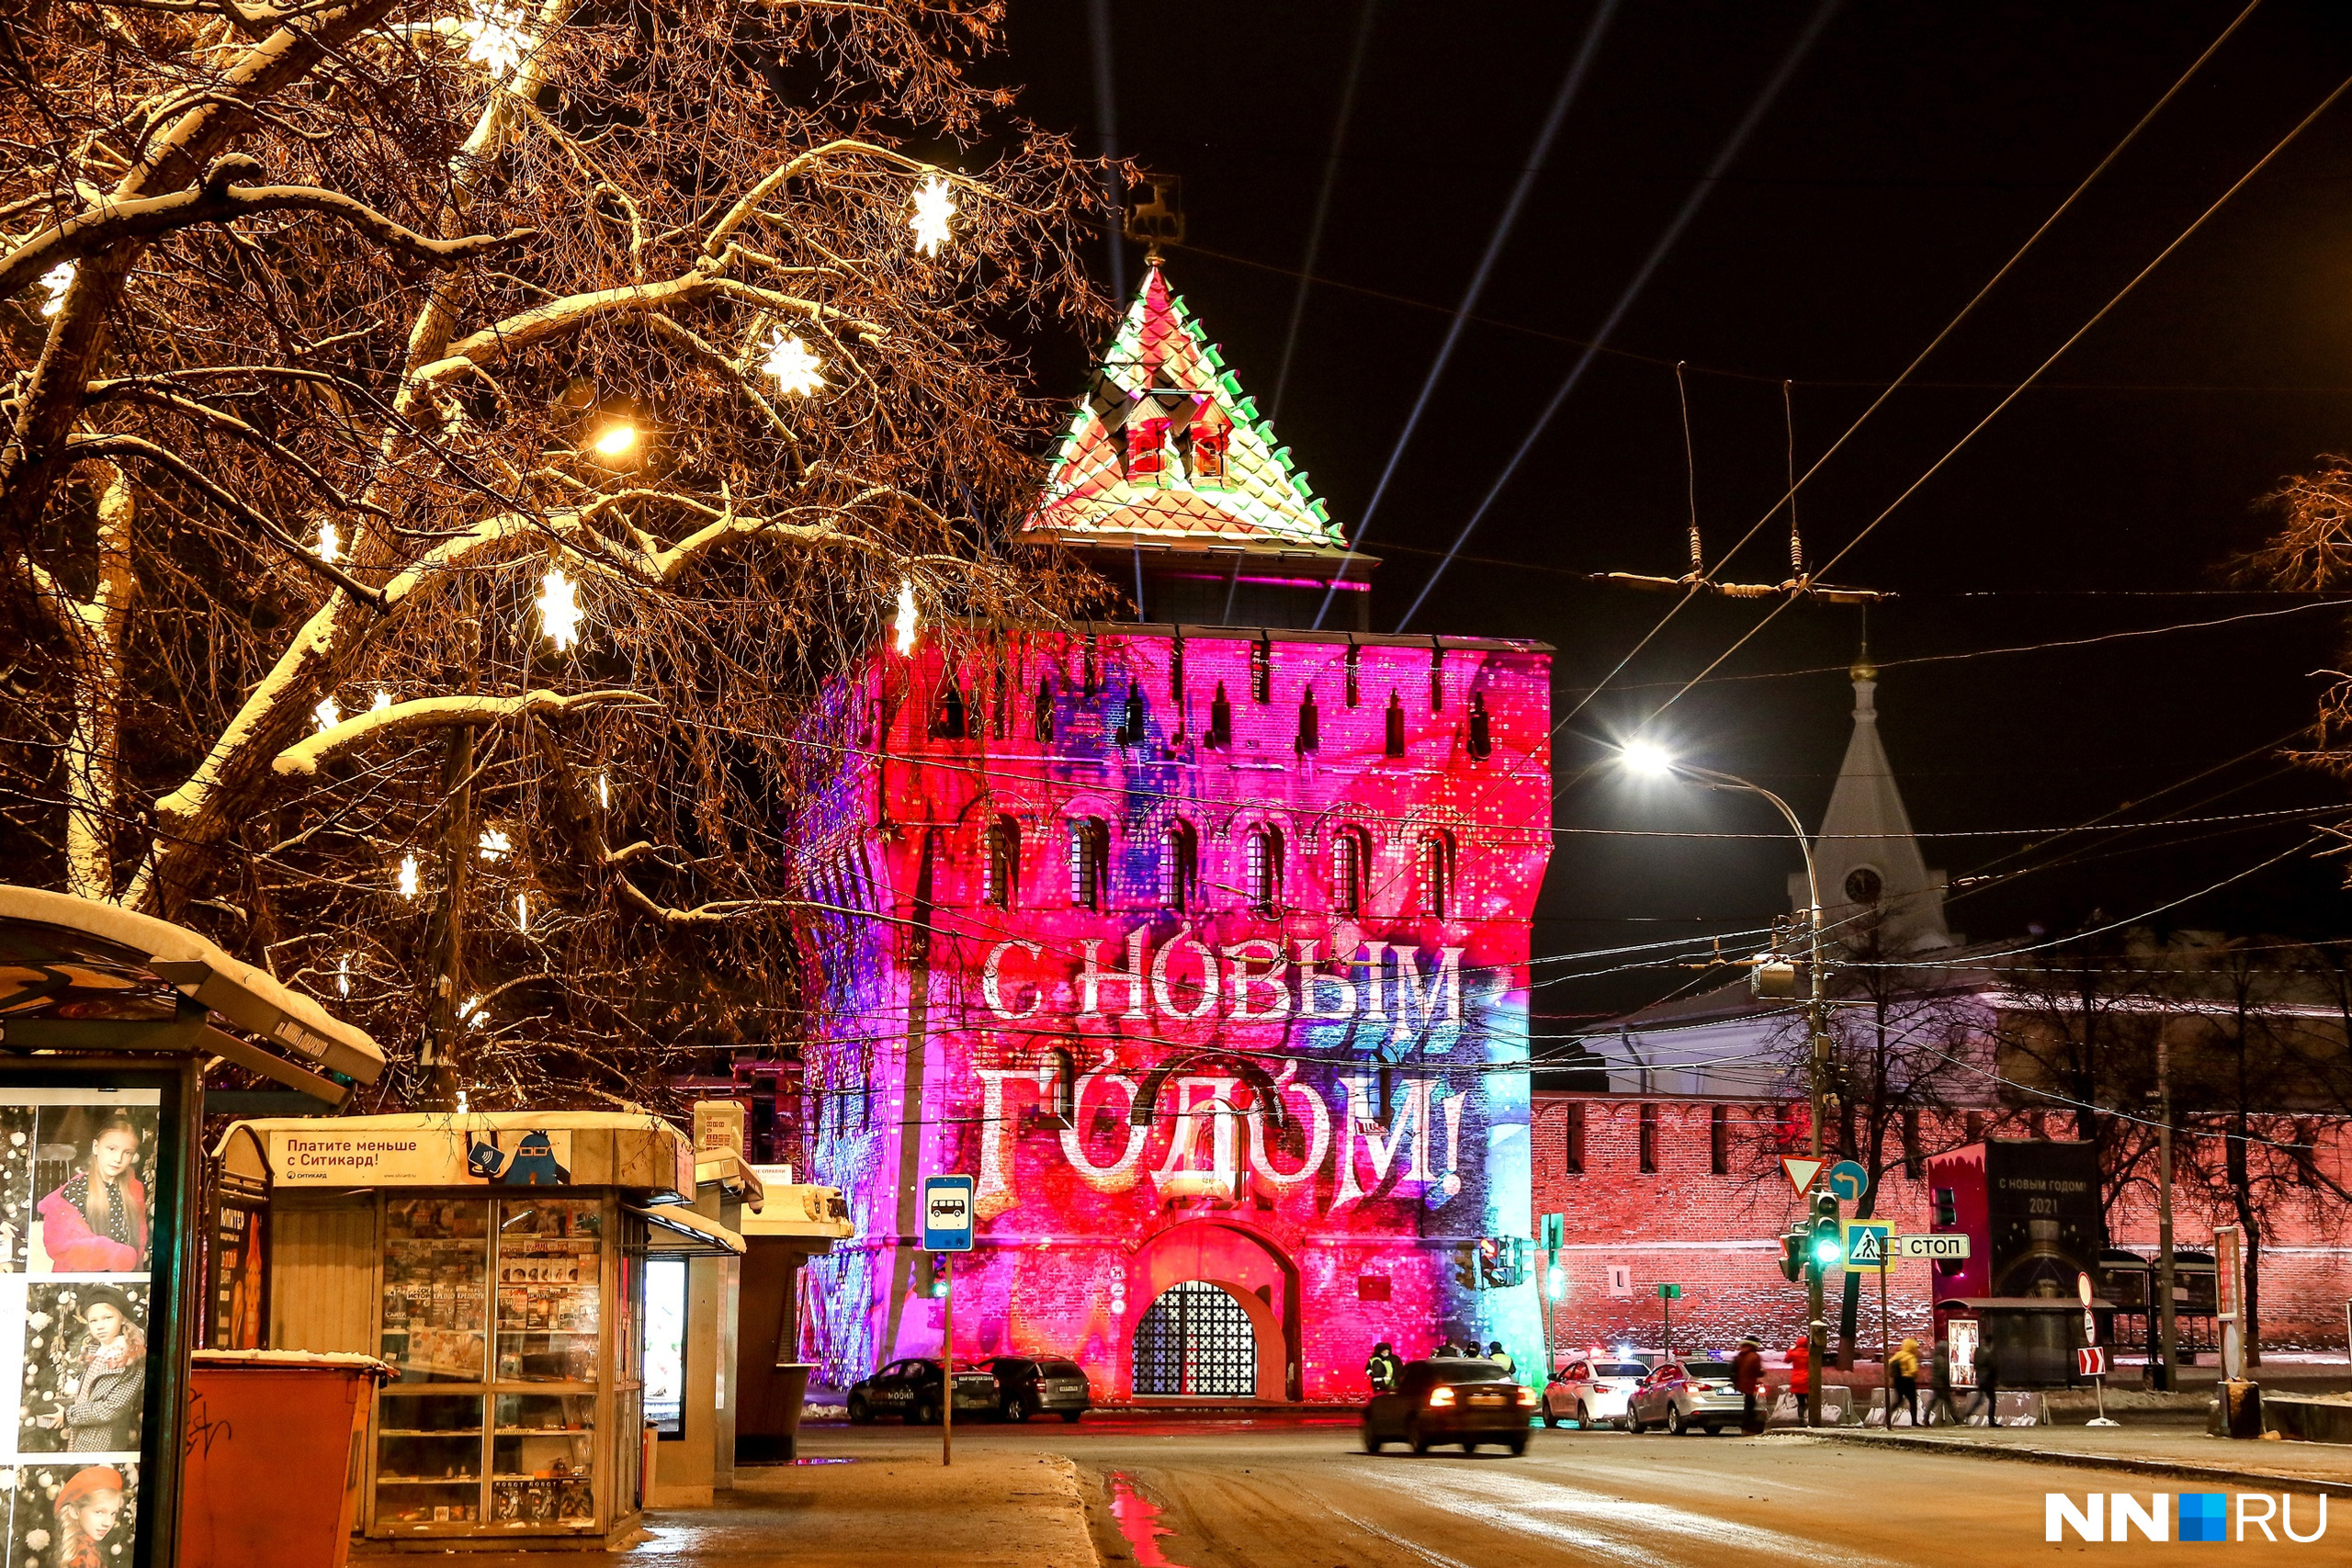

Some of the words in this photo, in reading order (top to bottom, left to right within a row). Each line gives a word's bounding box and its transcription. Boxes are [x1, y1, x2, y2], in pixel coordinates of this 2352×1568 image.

[983, 940, 1043, 1020] С
[1074, 921, 1466, 1041] НОВЫМ
[288, 1139, 351, 1151] Платите
[356, 1141, 417, 1151] меньше
[288, 1156, 296, 1166] с
[300, 1154, 379, 1168] Ситикард!
[1999, 1179, 2007, 1189] С
[2009, 1179, 2047, 1190] НОВЫМ
[2049, 1180, 2086, 1192] ГОДОМ!
[2030, 1198, 2057, 1213] 2021
[1911, 1240, 1960, 1254] СТОП
